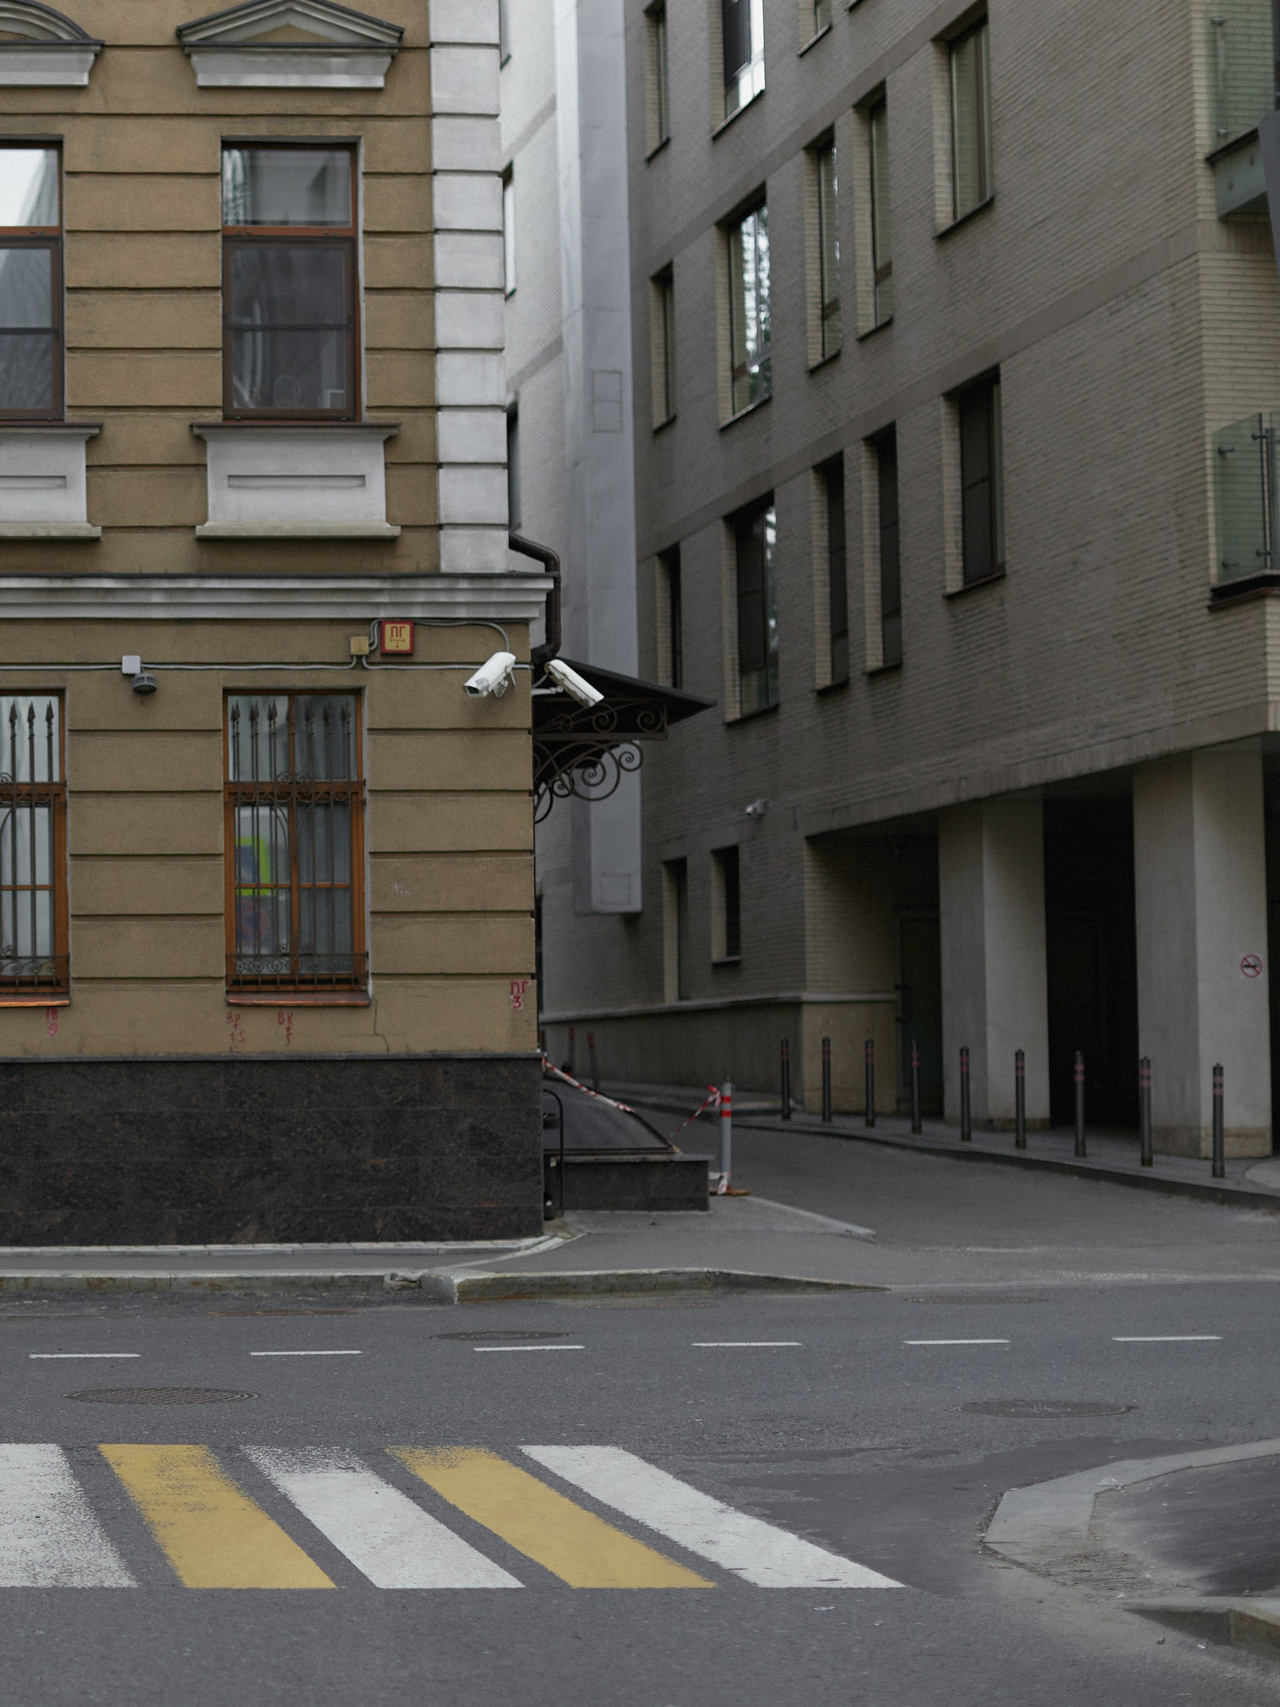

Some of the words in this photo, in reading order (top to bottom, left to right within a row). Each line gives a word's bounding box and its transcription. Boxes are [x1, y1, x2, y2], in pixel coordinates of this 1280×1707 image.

[391, 626, 405, 638] ПГ
[510, 980, 529, 995] ПГ
[512, 995, 522, 1009] 3
